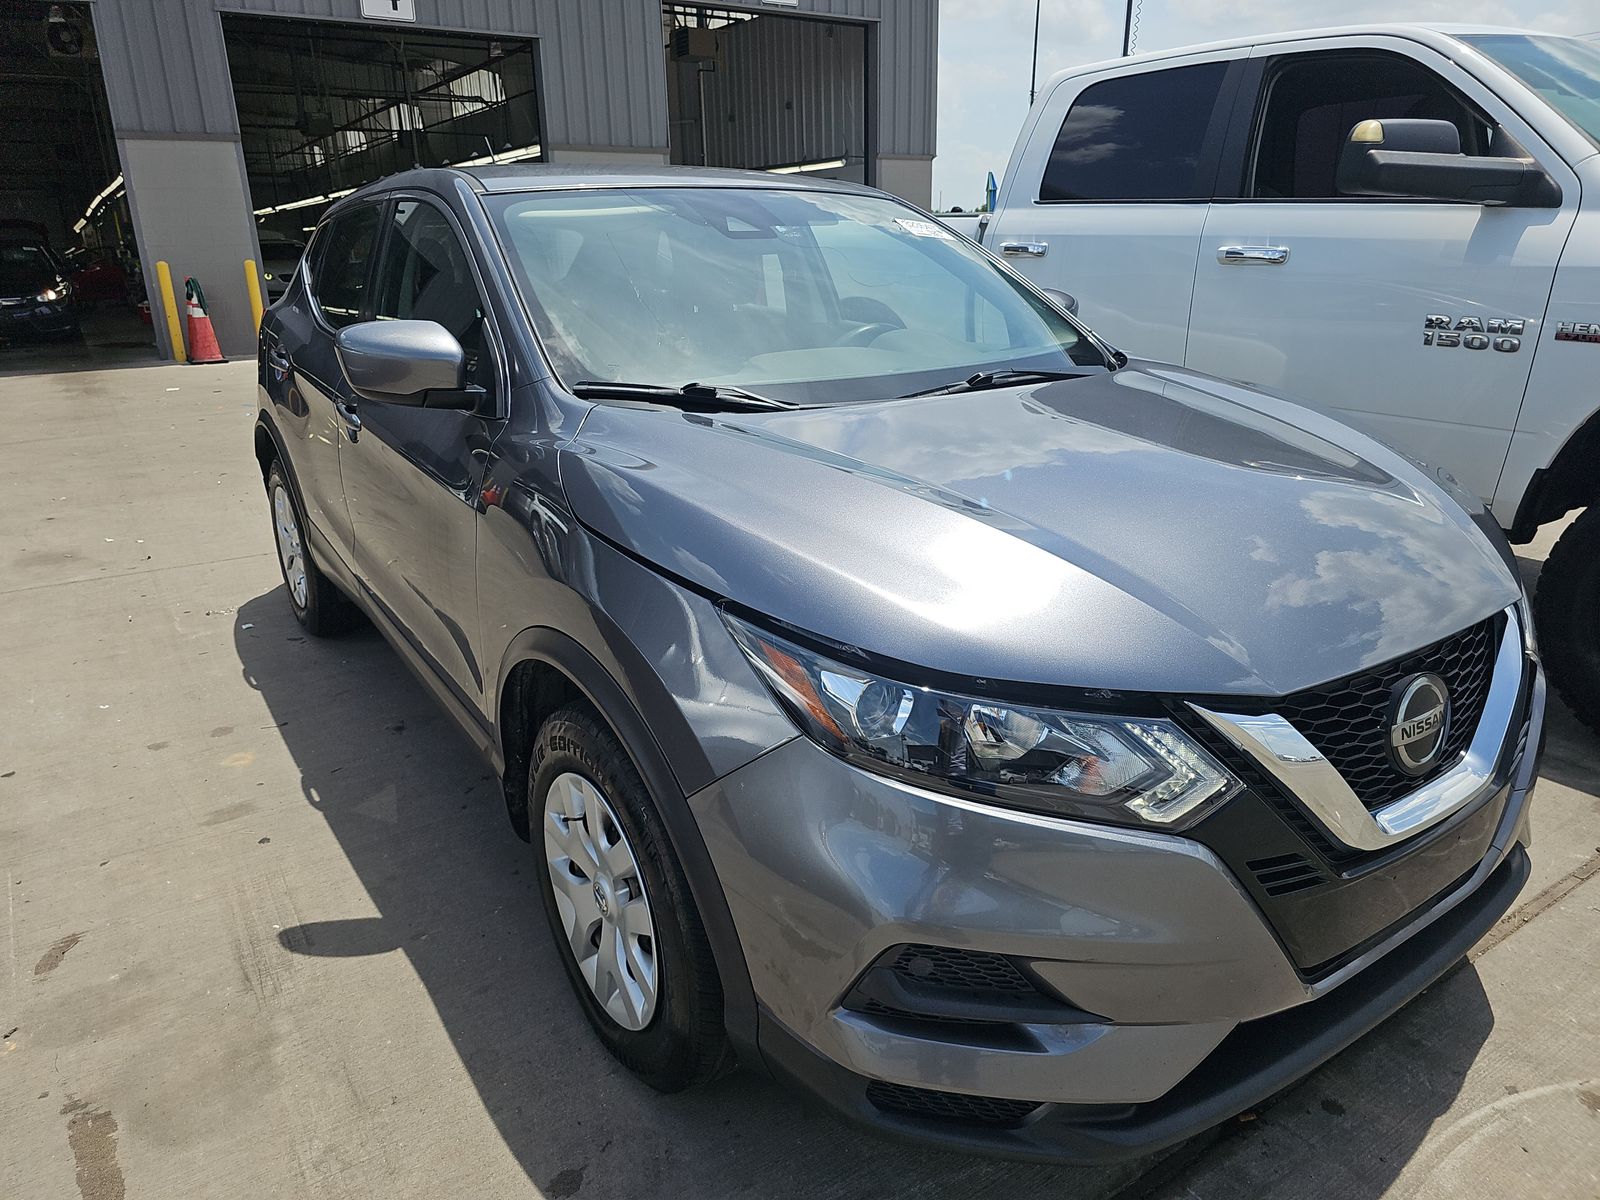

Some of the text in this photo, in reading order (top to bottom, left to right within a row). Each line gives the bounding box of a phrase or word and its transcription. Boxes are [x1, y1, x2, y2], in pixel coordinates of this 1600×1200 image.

[1424, 314, 1525, 335] RAM
[1423, 330, 1521, 353] 1500
[1401, 710, 1444, 740] NISSAN
